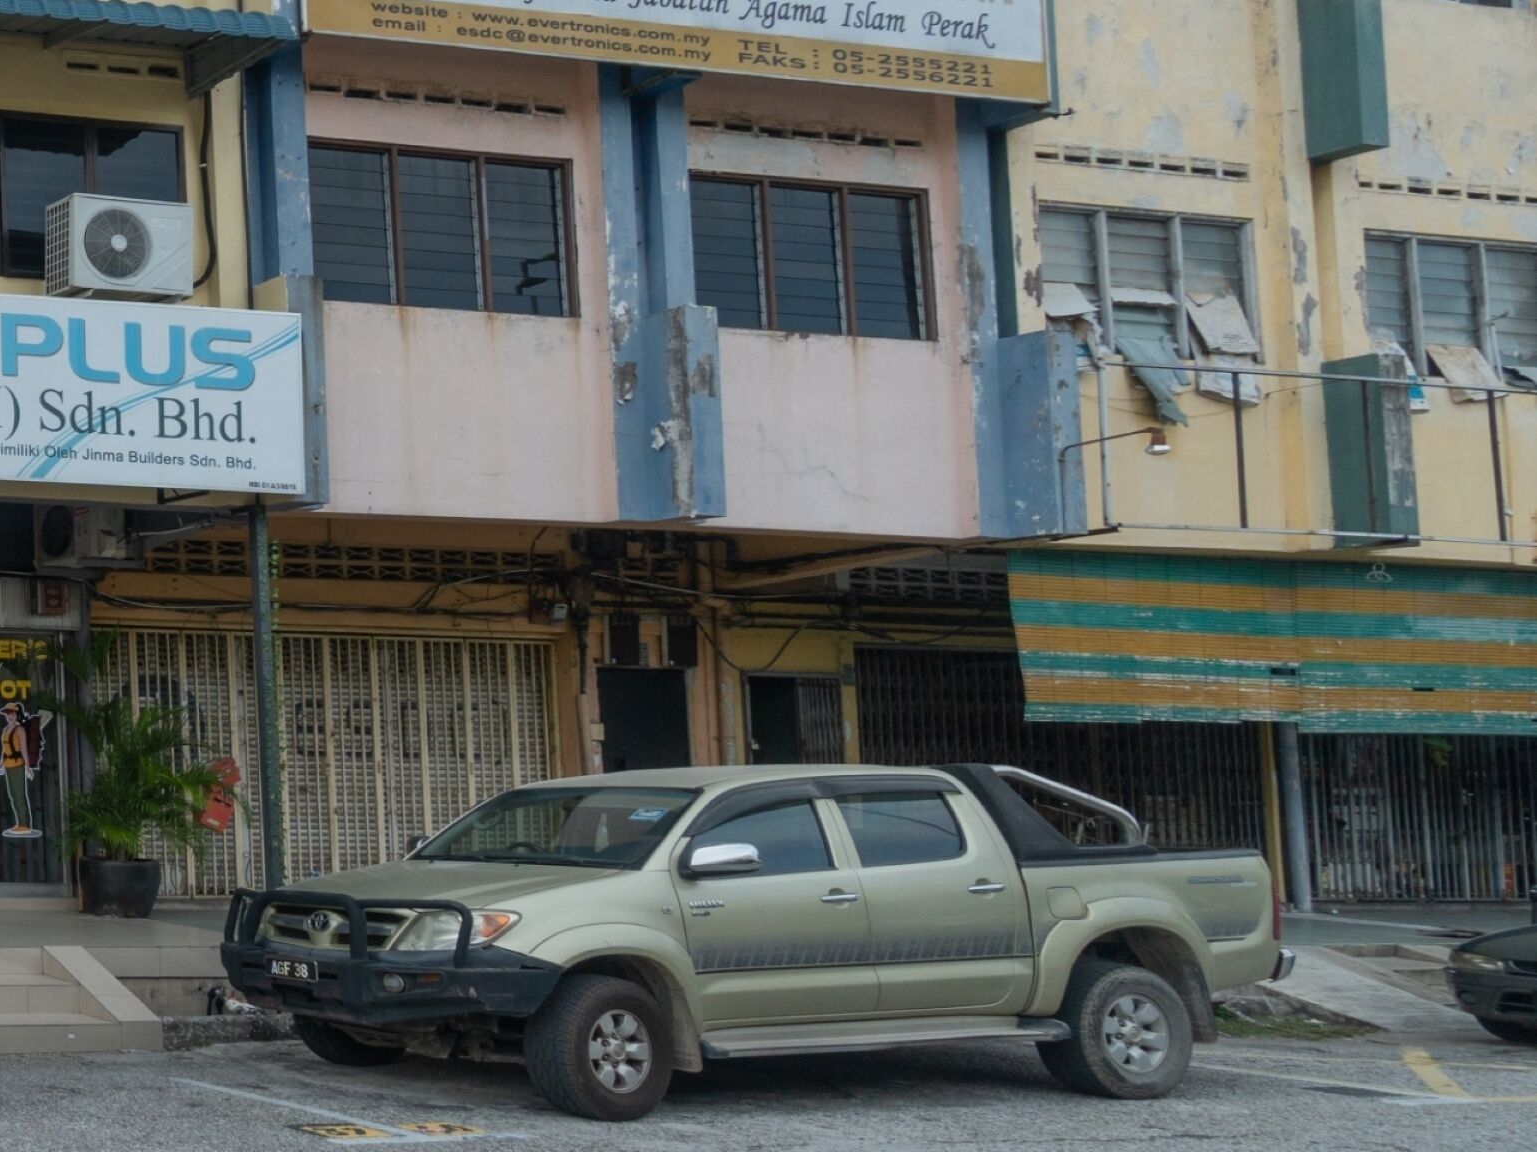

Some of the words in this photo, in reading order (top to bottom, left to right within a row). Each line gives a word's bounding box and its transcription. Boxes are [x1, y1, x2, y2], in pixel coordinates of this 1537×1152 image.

[371, 2, 448, 18] website
[472, 10, 710, 46] www.evertronics.com.my
[738, 39, 787, 54] TEL
[372, 16, 426, 32] email
[457, 24, 711, 62] esdc@evertronics.com.my
[738, 53, 806, 69] FAKS
[841, 1, 906, 32] Islam
[922, 11, 995, 49] Perak
[1, 313, 255, 391] PLUS
[39, 389, 135, 436] Sdn.
[155, 396, 256, 444] Bhd.
[44, 445, 77, 459] Oleh
[82, 447, 124, 462] Jinma
[128, 450, 185, 466] Builders
[189, 454, 221, 468] Sdn.
[226, 455, 256, 470] Bhd.
[271, 960, 291, 975] AGF
[294, 962, 308, 978] 38
